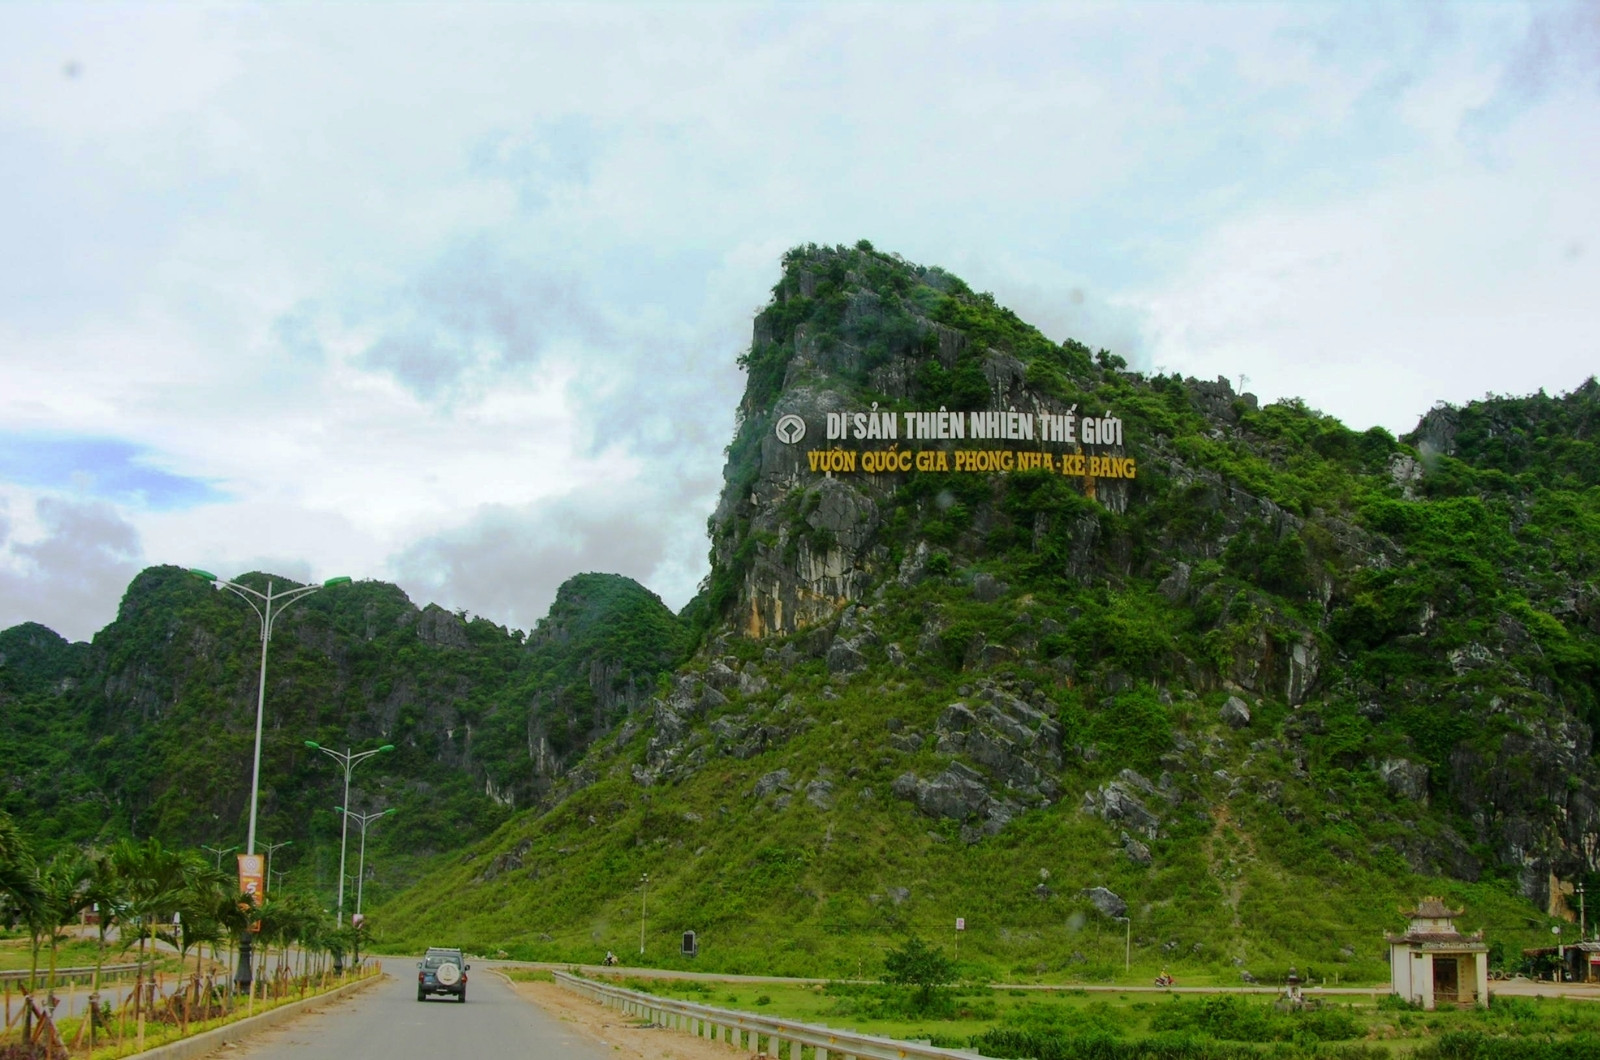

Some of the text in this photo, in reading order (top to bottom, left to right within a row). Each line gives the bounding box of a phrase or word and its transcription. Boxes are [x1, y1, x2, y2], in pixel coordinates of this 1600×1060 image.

[827, 401, 1123, 446] DI SẢN THIÊN NHIÊN THẾ GIỚI
[861, 442, 913, 473] QUỐC
[915, 450, 949, 472] GIA
[954, 450, 1015, 472] PHONG
